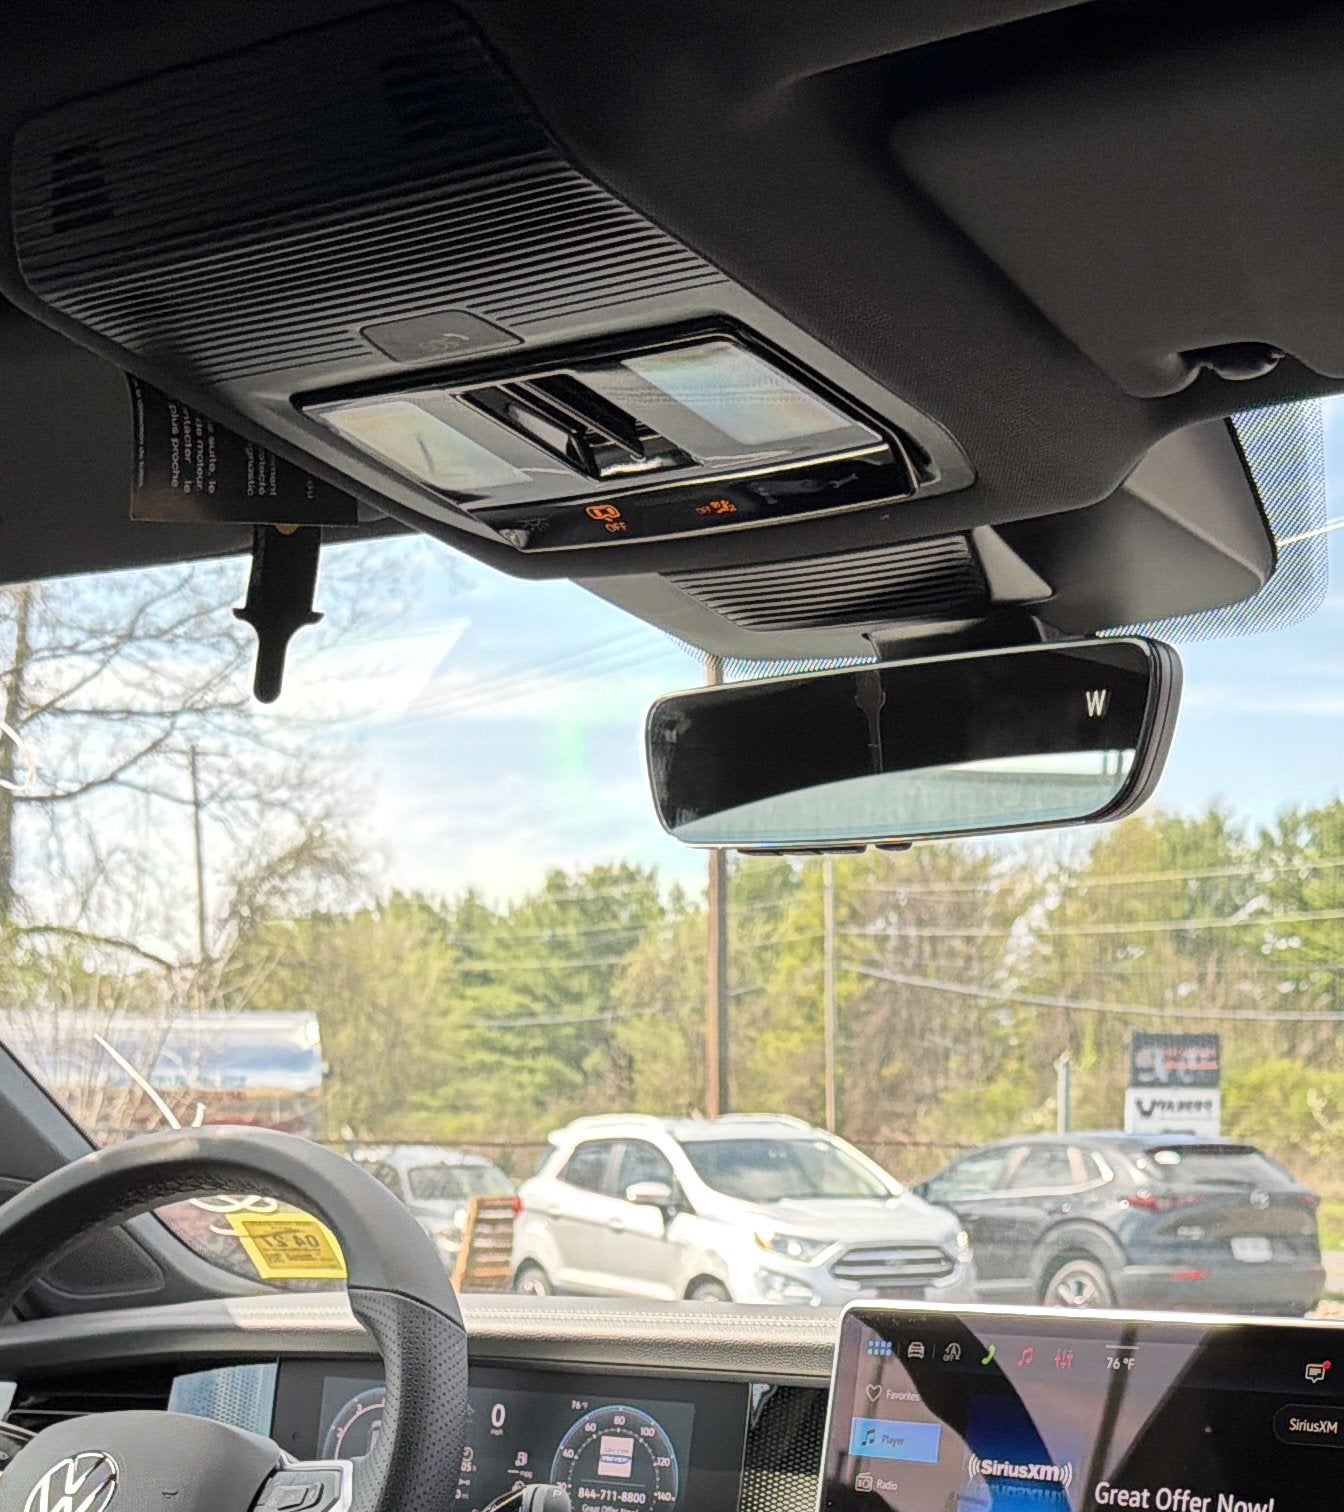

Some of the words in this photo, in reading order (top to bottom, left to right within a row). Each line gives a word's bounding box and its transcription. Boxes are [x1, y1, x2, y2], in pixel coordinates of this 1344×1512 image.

[171, 438, 181, 488] proche
[605, 521, 627, 532] OFF
[1086, 689, 1107, 717] W
[1106, 1357, 1121, 1370] 76
[886, 1389, 920, 1401] Favorites
[491, 1403, 506, 1428] 0
[614, 1416, 625, 1425] 80
[640, 1426, 655, 1437] 100
[1289, 1418, 1338, 1434] SiriusXM
[882, 1434, 905, 1447] Player
[657, 1457, 671, 1467] 120
[876, 1479, 898, 1491] Radio
[577, 1486, 646, 1504] 844-711-8800
[1094, 1481, 1151, 1509] Great
